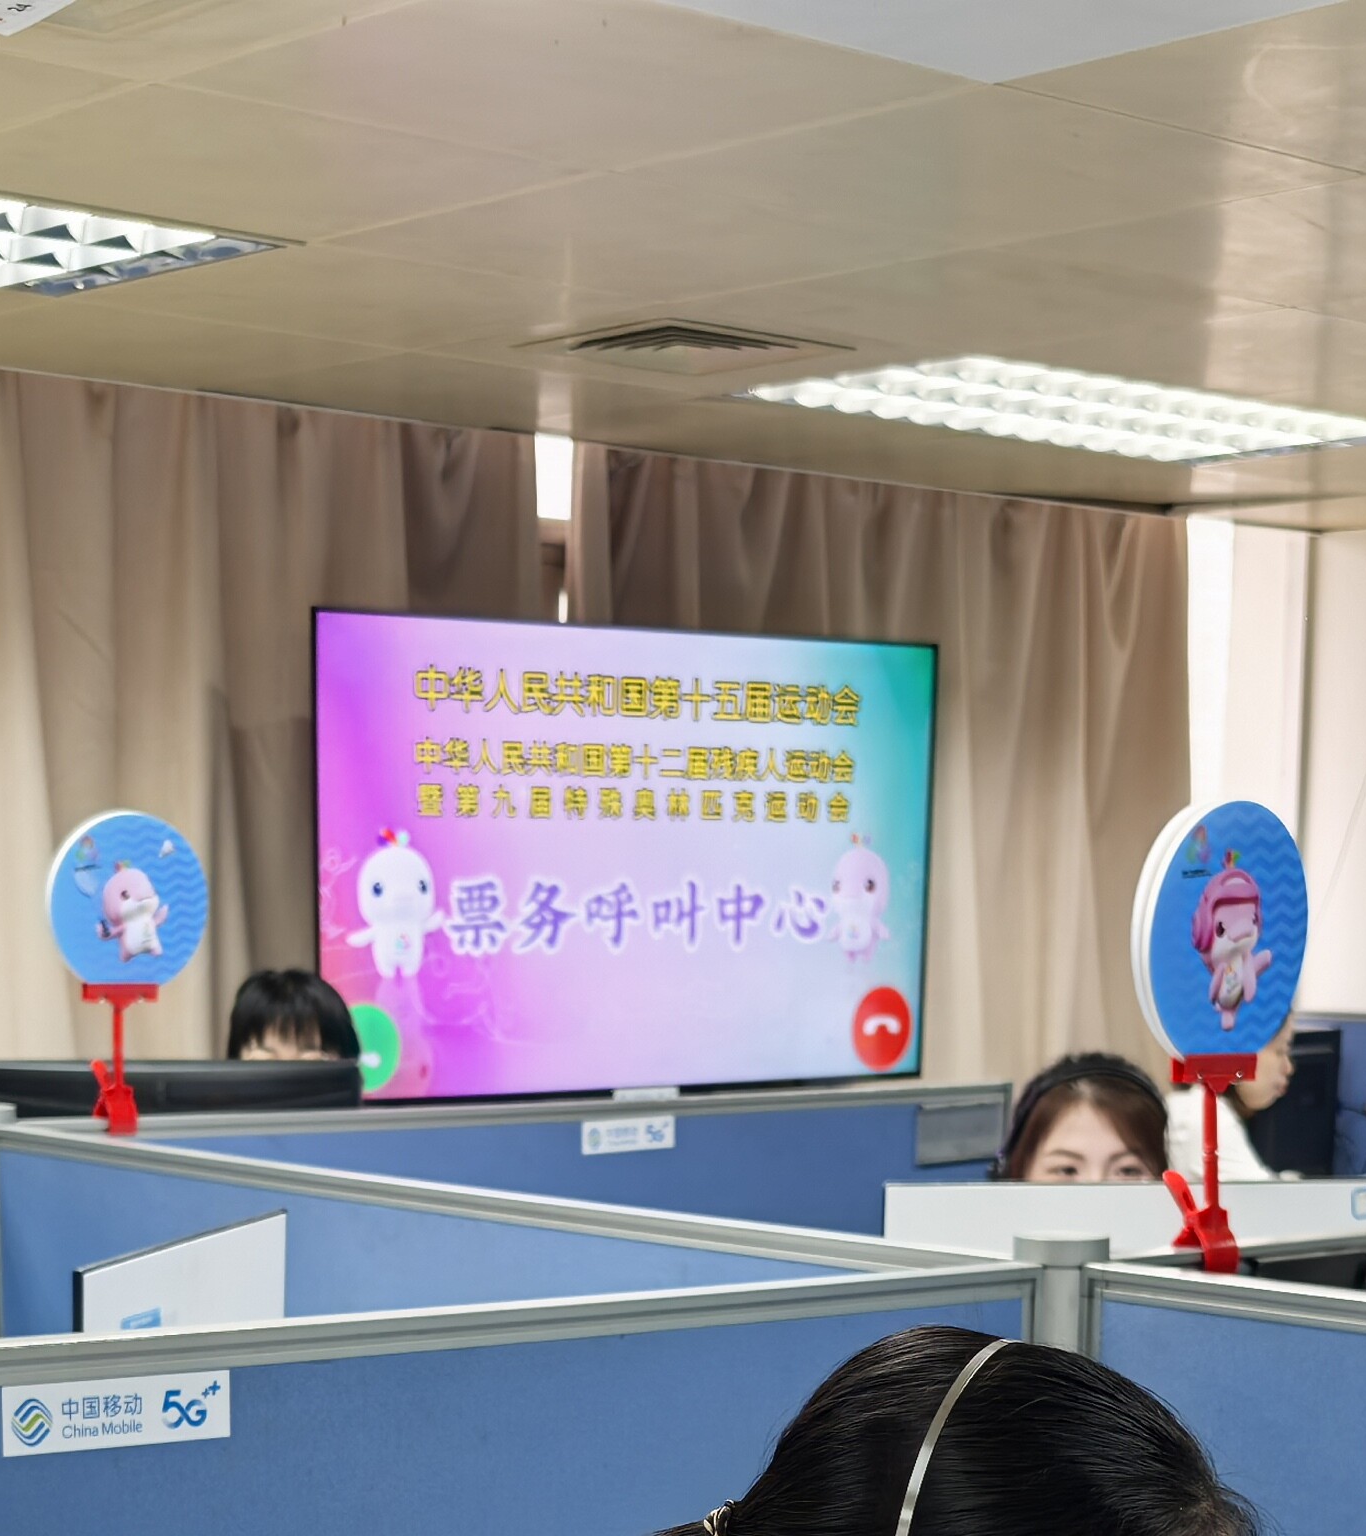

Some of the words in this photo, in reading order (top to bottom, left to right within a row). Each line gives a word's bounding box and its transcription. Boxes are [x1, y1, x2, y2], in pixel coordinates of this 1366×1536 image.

[414, 665, 861, 728] 中华人民共和国第十五届运动会
[415, 738, 856, 785] 中华人民共和国第十二届残疾人运动会
[416, 783, 851, 823] 暨第九届特殊奥林匹克运动会
[448, 879, 828, 953] 票务呼叫中心
[62, 1393, 143, 1421] 中国移动
[62, 1424, 99, 1439] China
[102, 1420, 143, 1436] Mobile
